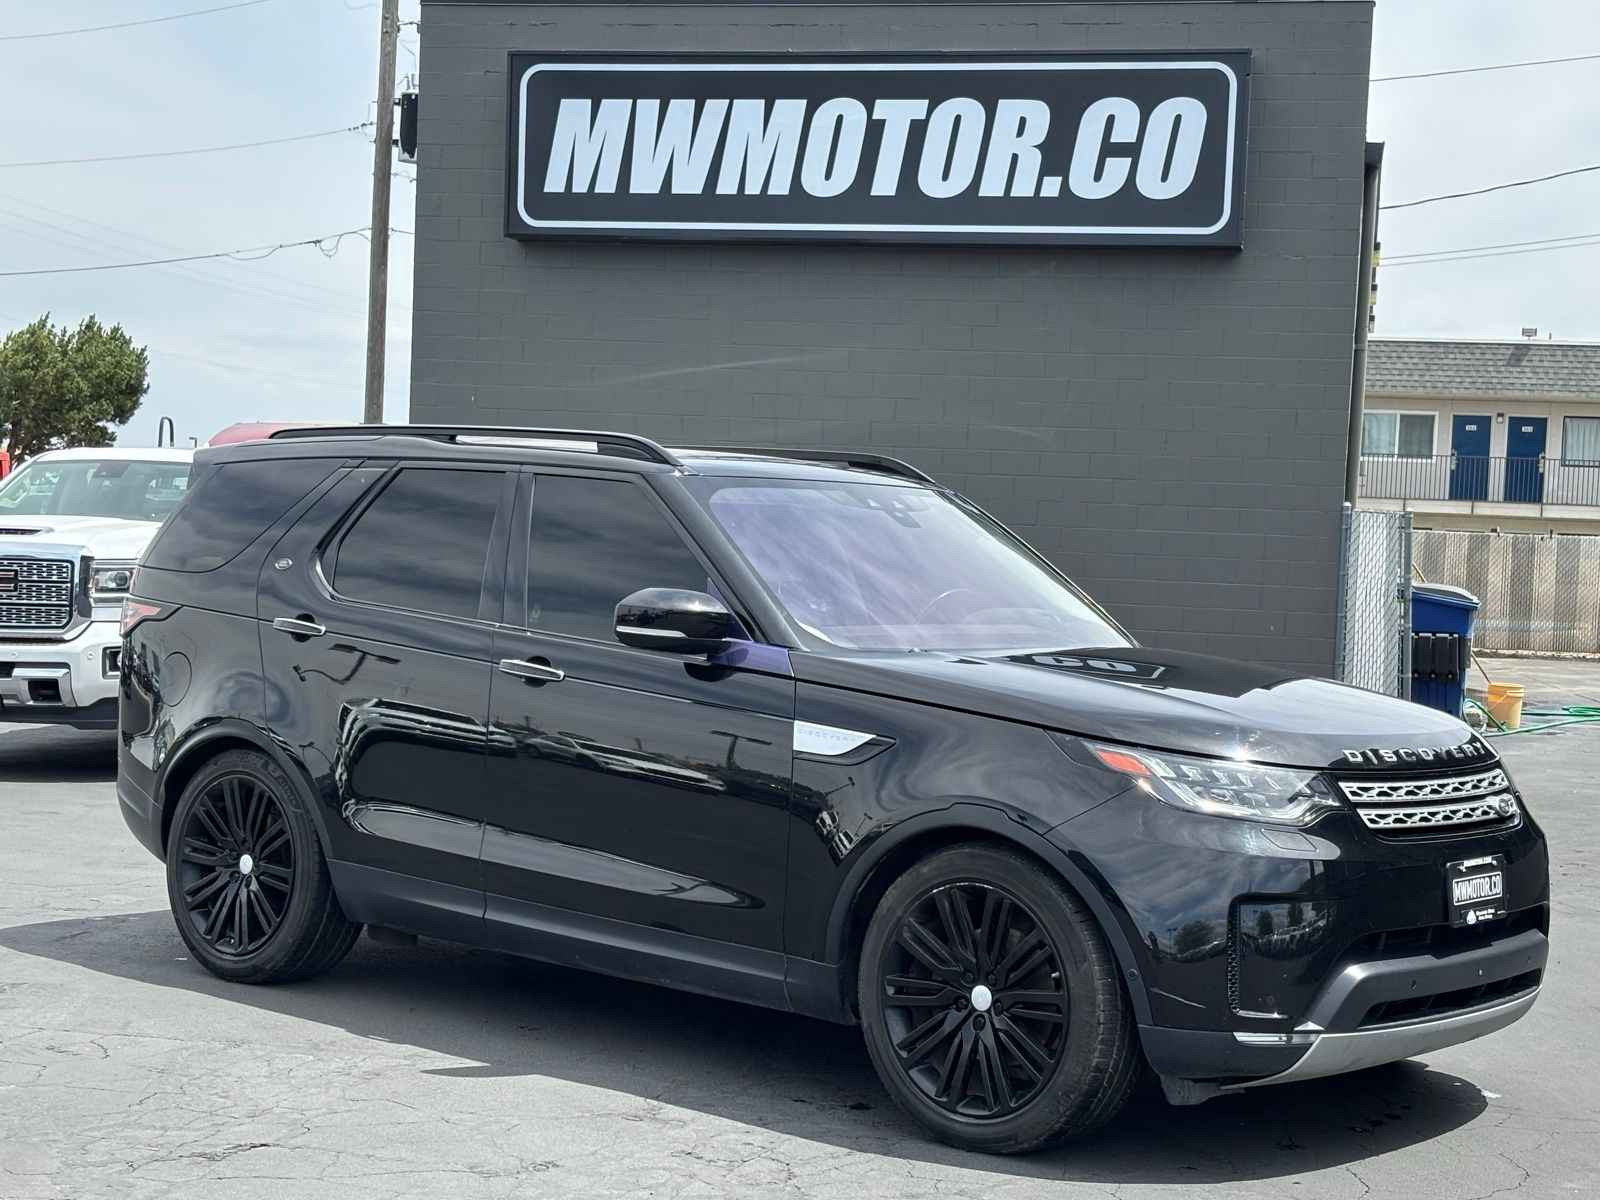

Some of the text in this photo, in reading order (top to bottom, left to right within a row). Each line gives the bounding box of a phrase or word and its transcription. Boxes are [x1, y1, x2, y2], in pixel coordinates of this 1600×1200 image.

[543, 96, 1209, 200] MWMOTOR.CO
[1342, 741, 1486, 765] DISCOVERY
[1454, 875, 1502, 902] MWMOTOR.CO
